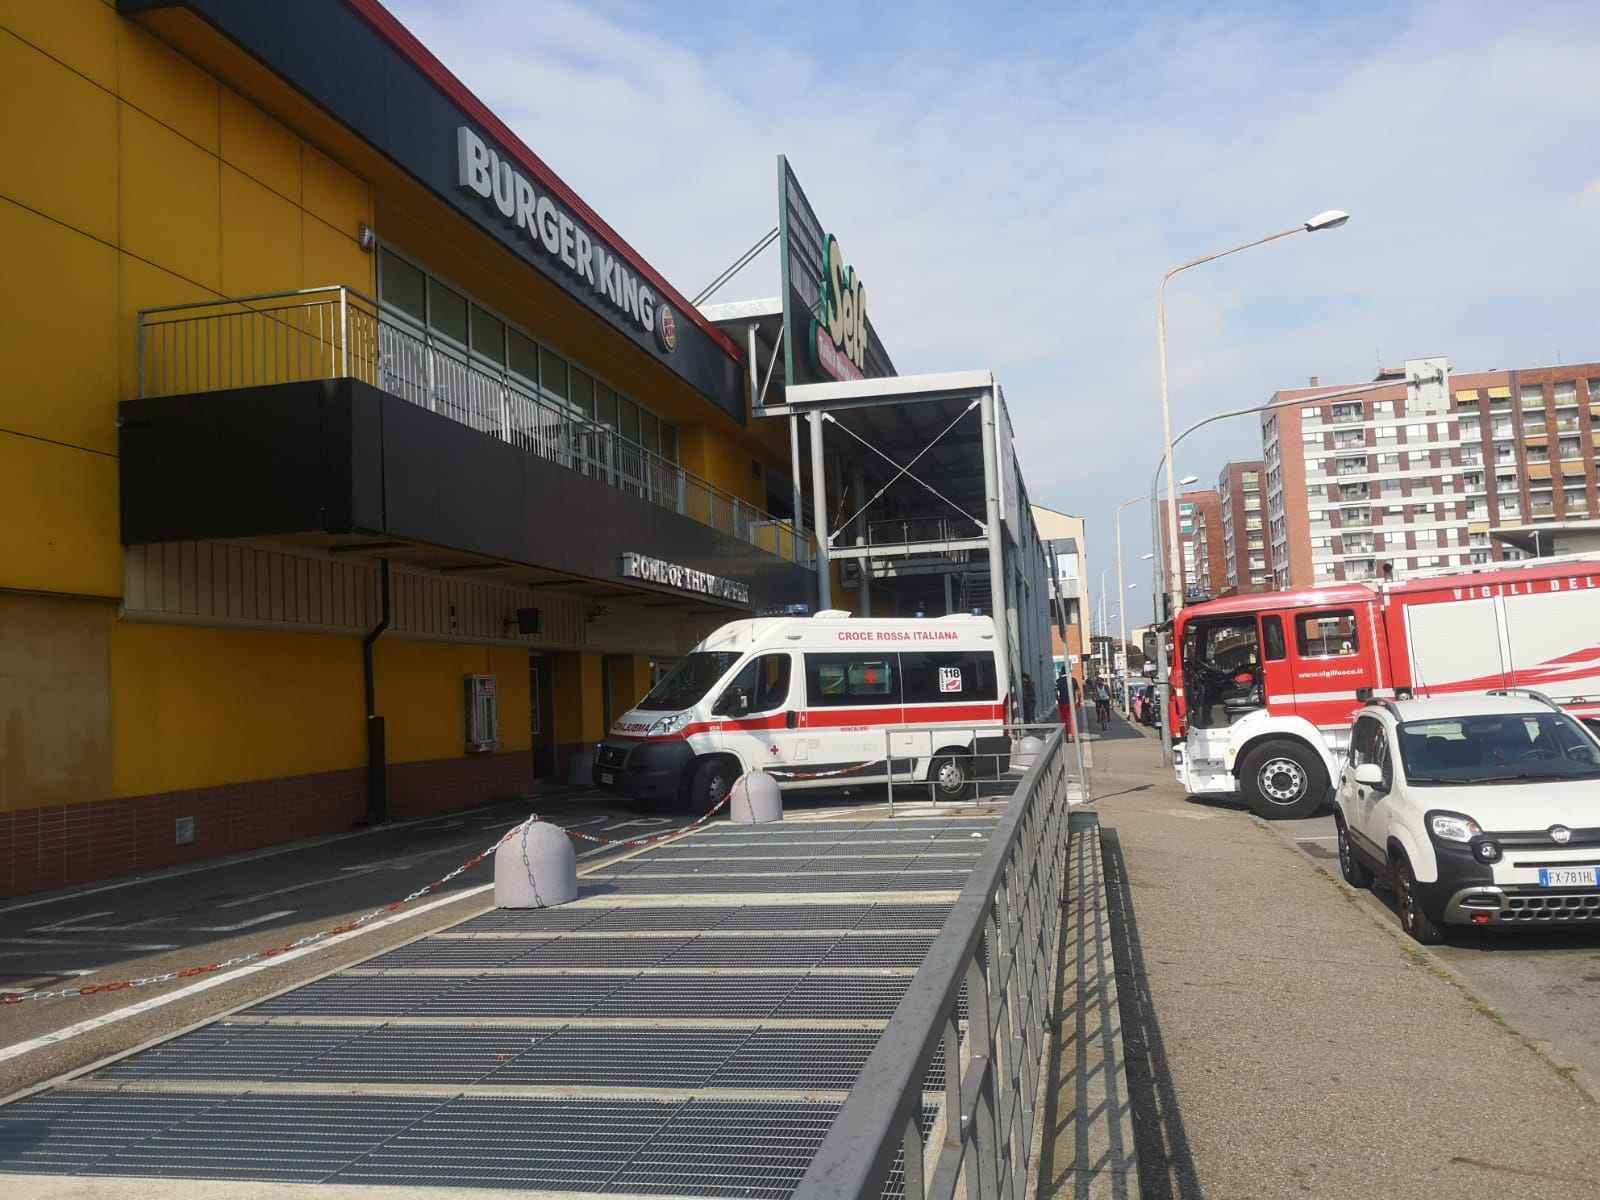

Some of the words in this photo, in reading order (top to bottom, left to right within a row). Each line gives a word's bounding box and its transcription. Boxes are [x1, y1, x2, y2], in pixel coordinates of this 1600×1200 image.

[457, 126, 594, 286] BURGER
[592, 245, 655, 332] KING
[827, 237, 867, 371] Self
[623, 552, 668, 584] HOME
[668, 563, 685, 587] OF
[684, 567, 707, 592] THE
[1453, 582, 1532, 600] VIGILI
[1549, 577, 1595, 591] DEL
[838, 632, 873, 640] CROCE
[876, 632, 910, 640] ROSSA
[913, 631, 958, 640] ITALIANA
[943, 669, 960, 678] 118
[1298, 668, 1364, 679] www.vigilfuoco.it
